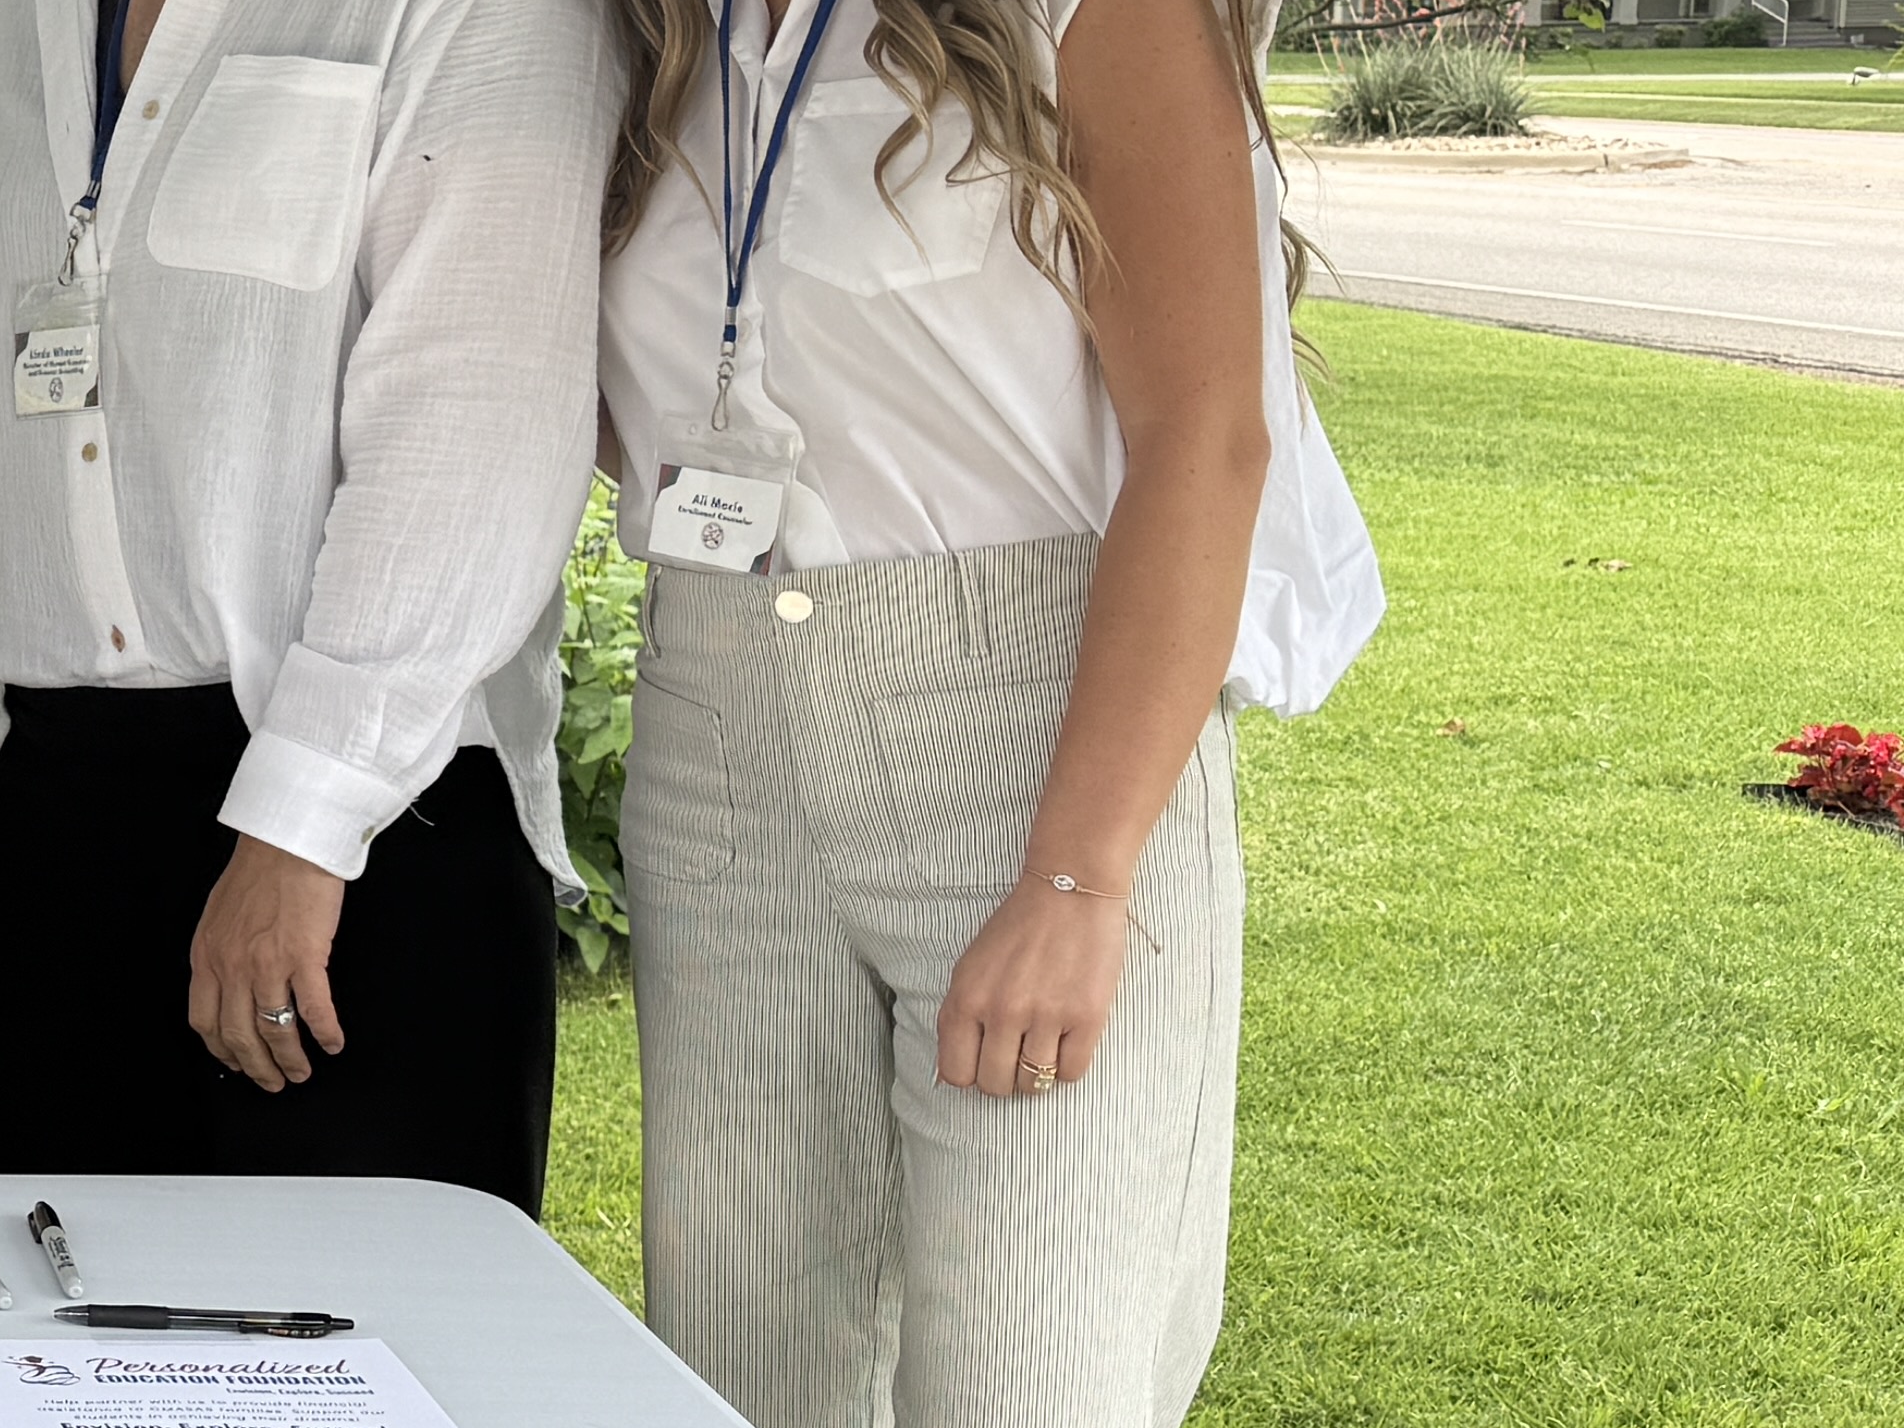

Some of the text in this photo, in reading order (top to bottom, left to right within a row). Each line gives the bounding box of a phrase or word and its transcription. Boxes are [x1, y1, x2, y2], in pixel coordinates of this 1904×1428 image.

[692, 494, 708, 507] Ali
[86, 1357, 350, 1374] Personalized
[94, 1374, 366, 1385] EDUCATION FOUNDATION
